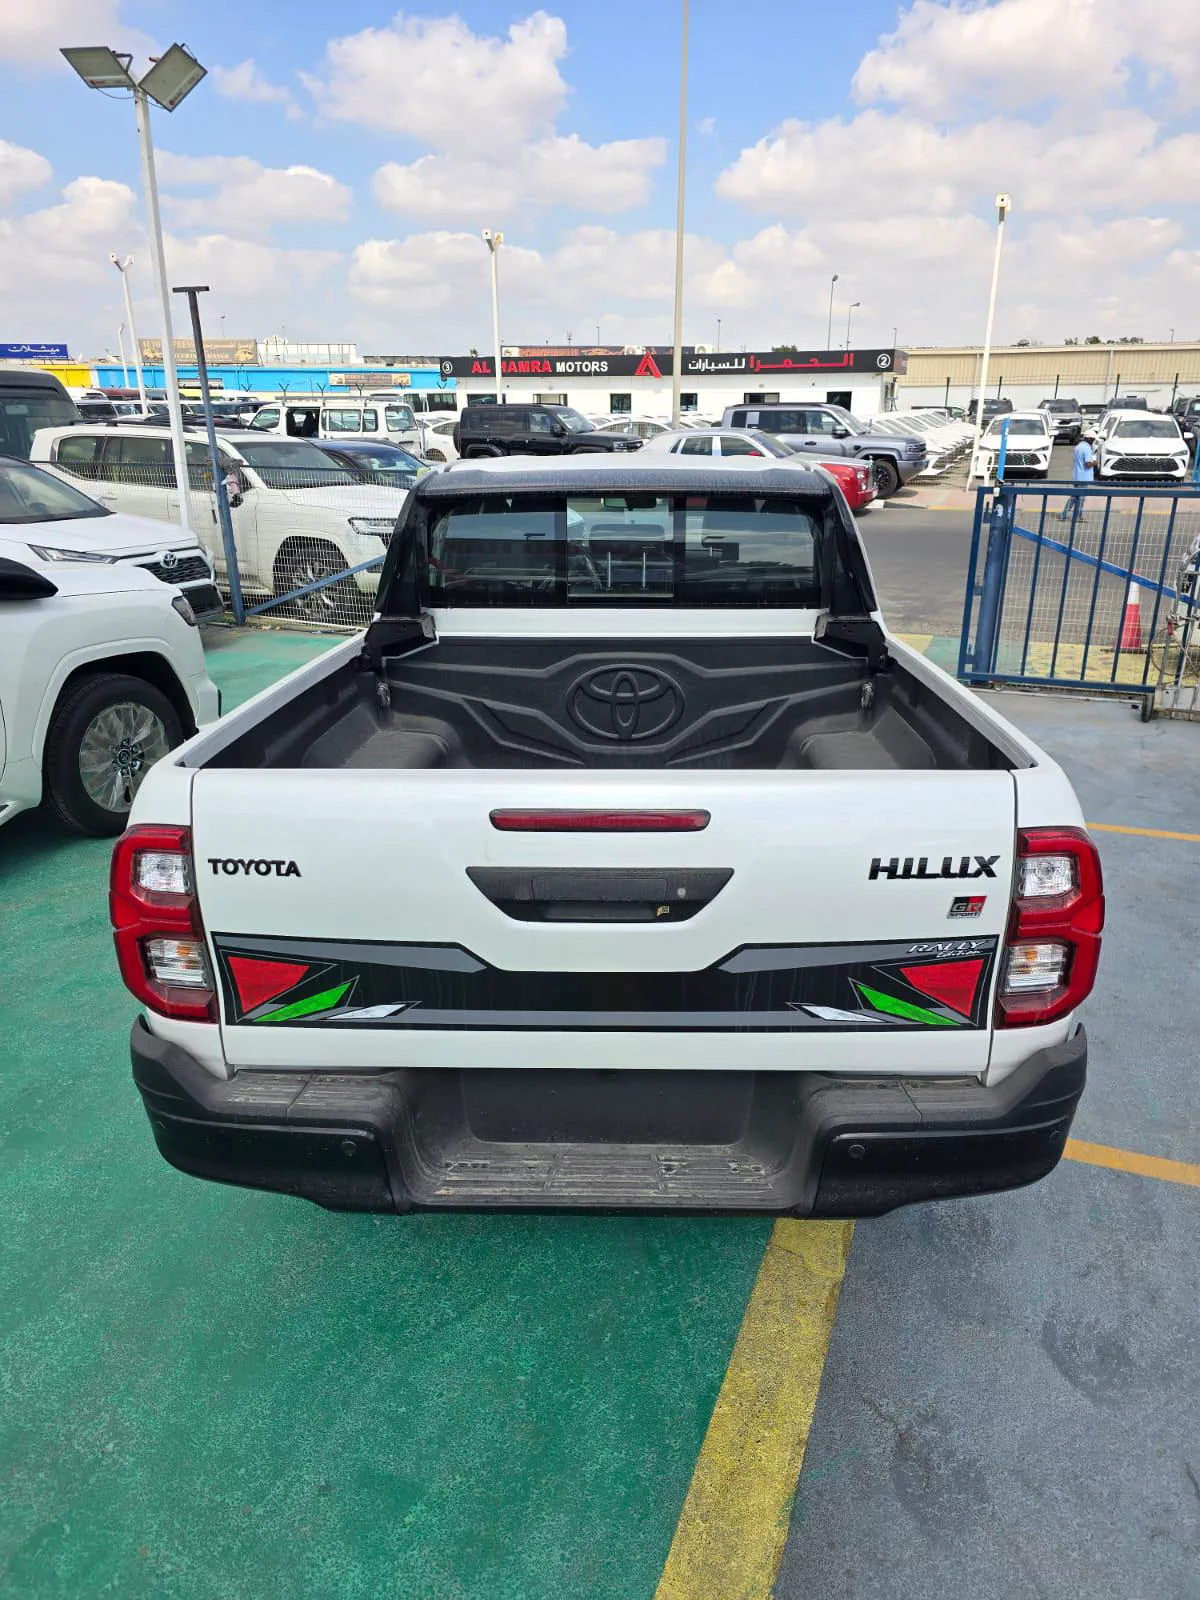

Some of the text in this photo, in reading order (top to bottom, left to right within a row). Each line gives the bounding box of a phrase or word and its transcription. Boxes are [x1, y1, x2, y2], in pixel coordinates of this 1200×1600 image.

[471, 360, 492, 374] AL
[555, 361, 609, 373] MOTORS
[688, 357, 746, 371] للسيارات
[207, 858, 302, 877] TOYOTA
[868, 855, 1000, 880] HILUX
[951, 902, 982, 913] GR
[907, 940, 987, 953] RALLY
